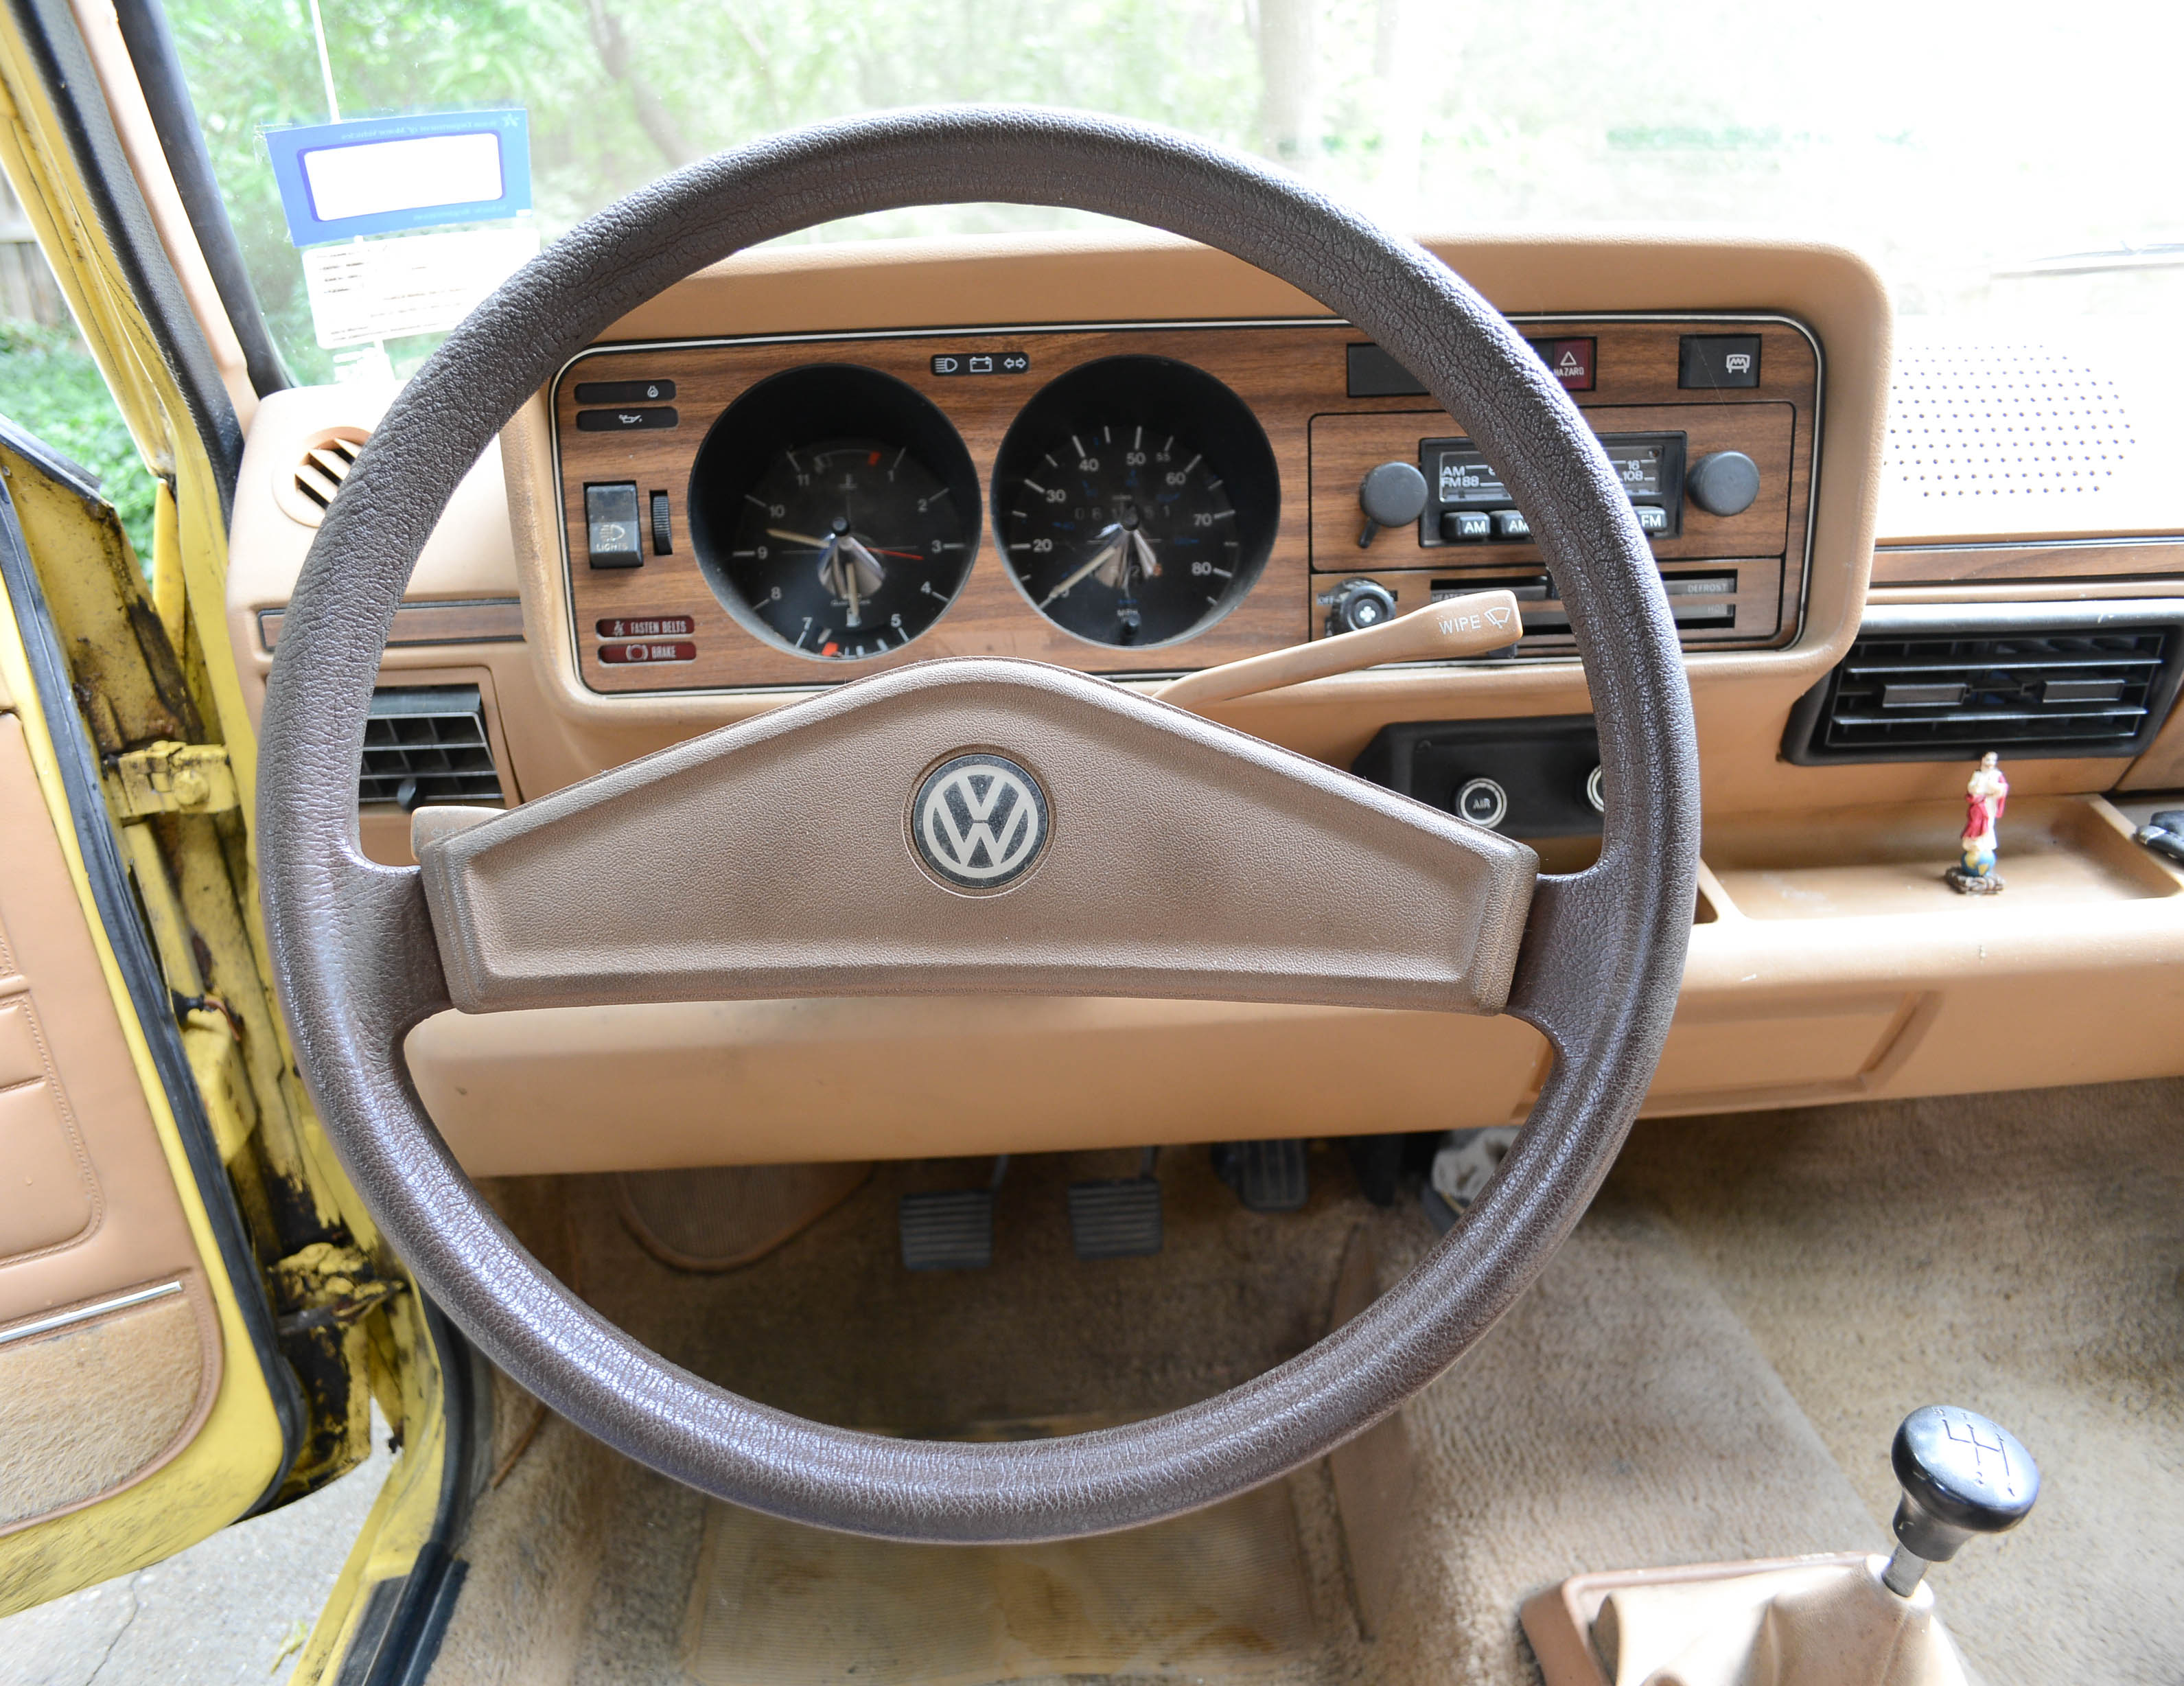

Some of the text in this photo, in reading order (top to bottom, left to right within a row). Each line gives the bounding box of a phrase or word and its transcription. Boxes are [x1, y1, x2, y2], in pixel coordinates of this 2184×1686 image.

[1553, 367, 1585, 377] HAZARD
[1126, 452, 1146, 466] 50
[1156, 452, 1171, 463] 55
[1079, 458, 1100, 472] 40
[1443, 465, 1465, 477] AM
[796, 474, 810, 486] 11
[887, 470, 894, 482] 1
[1166, 472, 1186, 485] 60
[1442, 476, 1479, 488] FM 88
[1622, 470, 1643, 482] 108
[1046, 489, 1066, 503] 30
[769, 503, 785, 518] 10
[917, 498, 927, 513] 2
[1193, 513, 1212, 527] 70
[1464, 520, 1486, 534] AM
[1509, 520, 1530, 533] AM
[1641, 514, 1661, 528] FM
[596, 543, 629, 553] LIGHTS
[931, 540, 942, 554] 3
[1032, 538, 1052, 553] 20
[757, 546, 768, 560] 9
[1192, 562, 1212, 576] 80
[770, 586, 781, 600] 8
[920, 581, 931, 594] 4
[1688, 582, 1728, 592] DEFROST
[631, 620, 686, 634] FASTEN BELTS
[802, 616, 813, 631] 7
[890, 613, 902, 628] 5
[1439, 614, 1481, 635] WIPE
[651, 645, 677, 660] BRAKE
[1472, 798, 1491, 809] AIR
[926, 769, 1035, 875] VW
